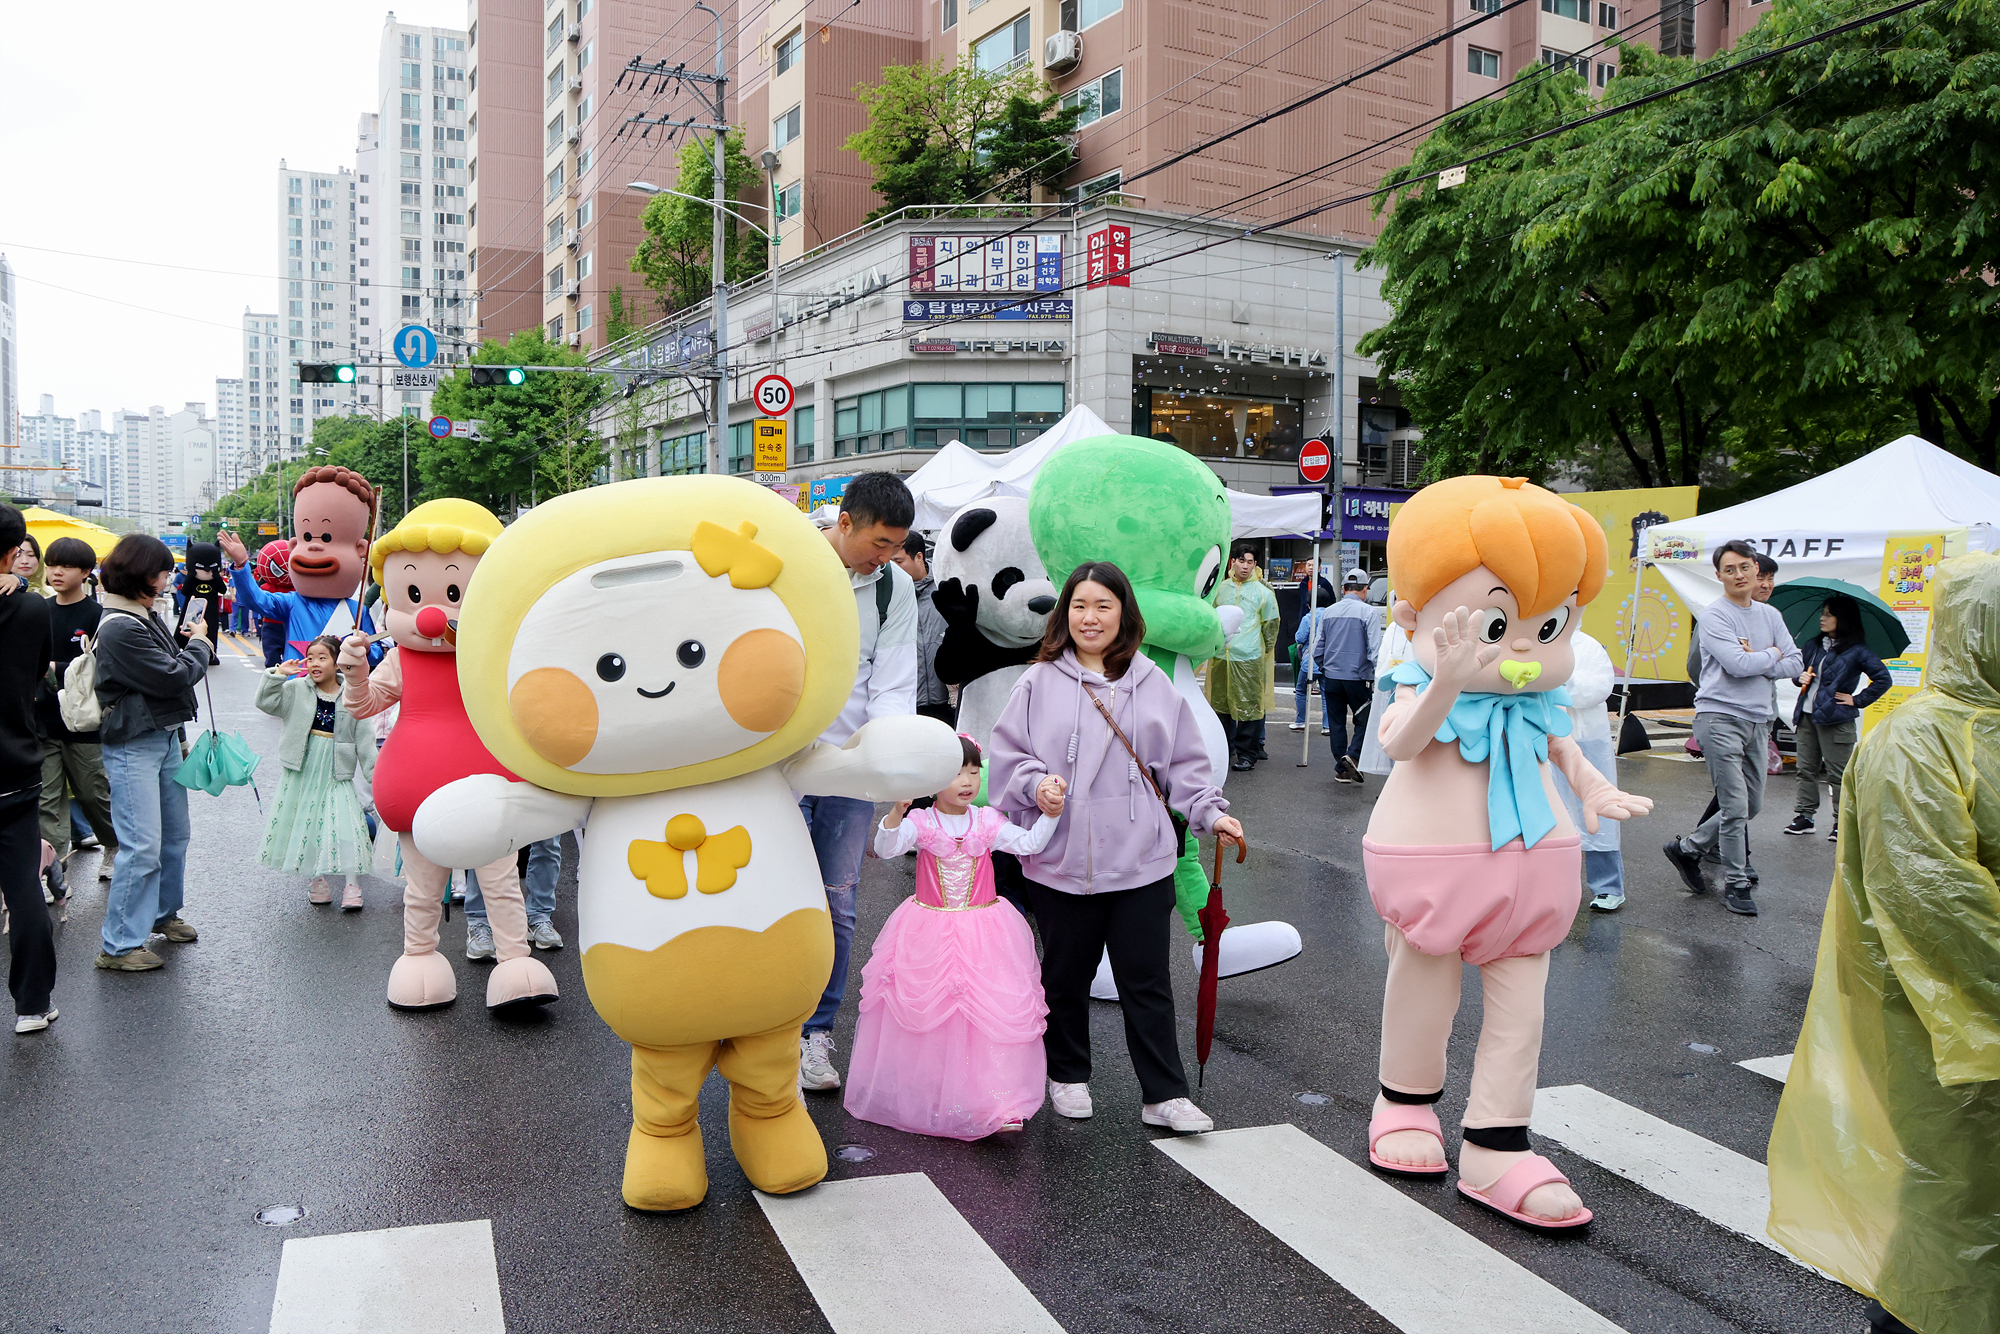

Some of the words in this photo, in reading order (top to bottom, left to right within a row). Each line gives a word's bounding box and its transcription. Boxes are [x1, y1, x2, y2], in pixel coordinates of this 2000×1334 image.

[940, 241, 954, 288] 치과
[965, 241, 979, 288] 안과
[990, 241, 1004, 288] 피부과
[1016, 240, 1030, 288] 한의원
[928, 301, 947, 314] 탑
[951, 302, 997, 314] 법무사
[1024, 301, 1070, 313] 사무소
[395, 373, 436, 387] 보행신호시
[763, 387, 786, 404] 50
[758, 443, 783, 452] 단속중
[1304, 455, 1326, 466] 진입금지
[759, 474, 781, 482] 300m
